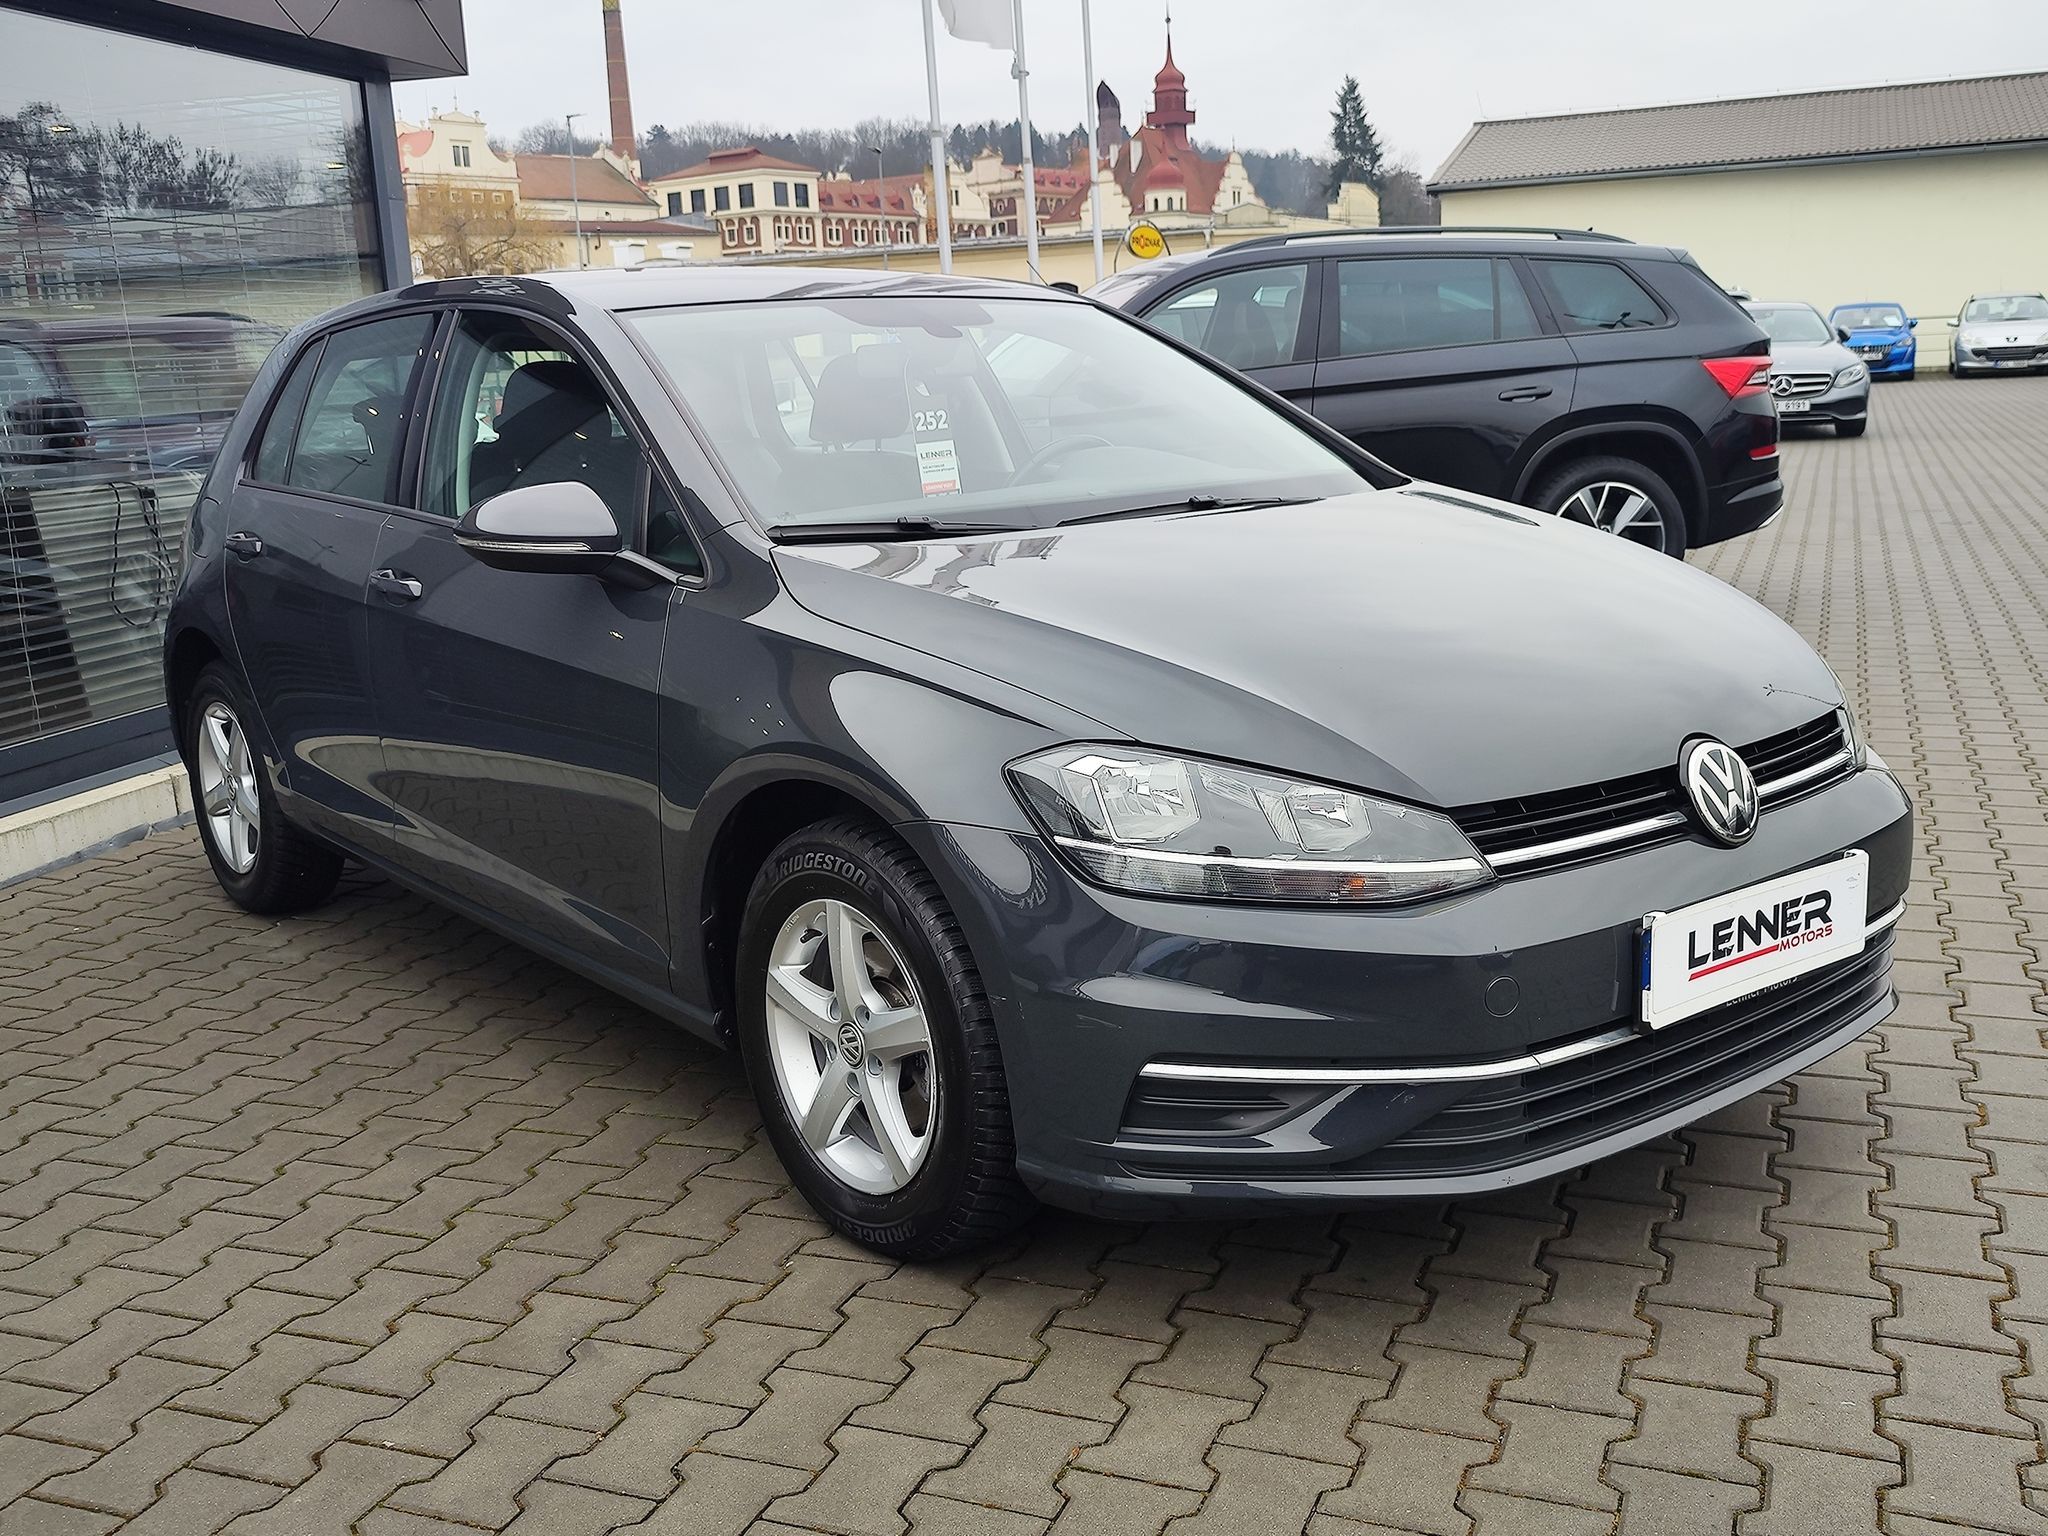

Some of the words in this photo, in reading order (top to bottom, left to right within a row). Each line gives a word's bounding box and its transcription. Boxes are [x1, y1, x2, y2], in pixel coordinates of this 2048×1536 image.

[914, 409, 949, 432] 252
[920, 449, 953, 460] LENNER
[1688, 889, 1833, 970] LENNER
[1779, 924, 1833, 952] MOTORS
